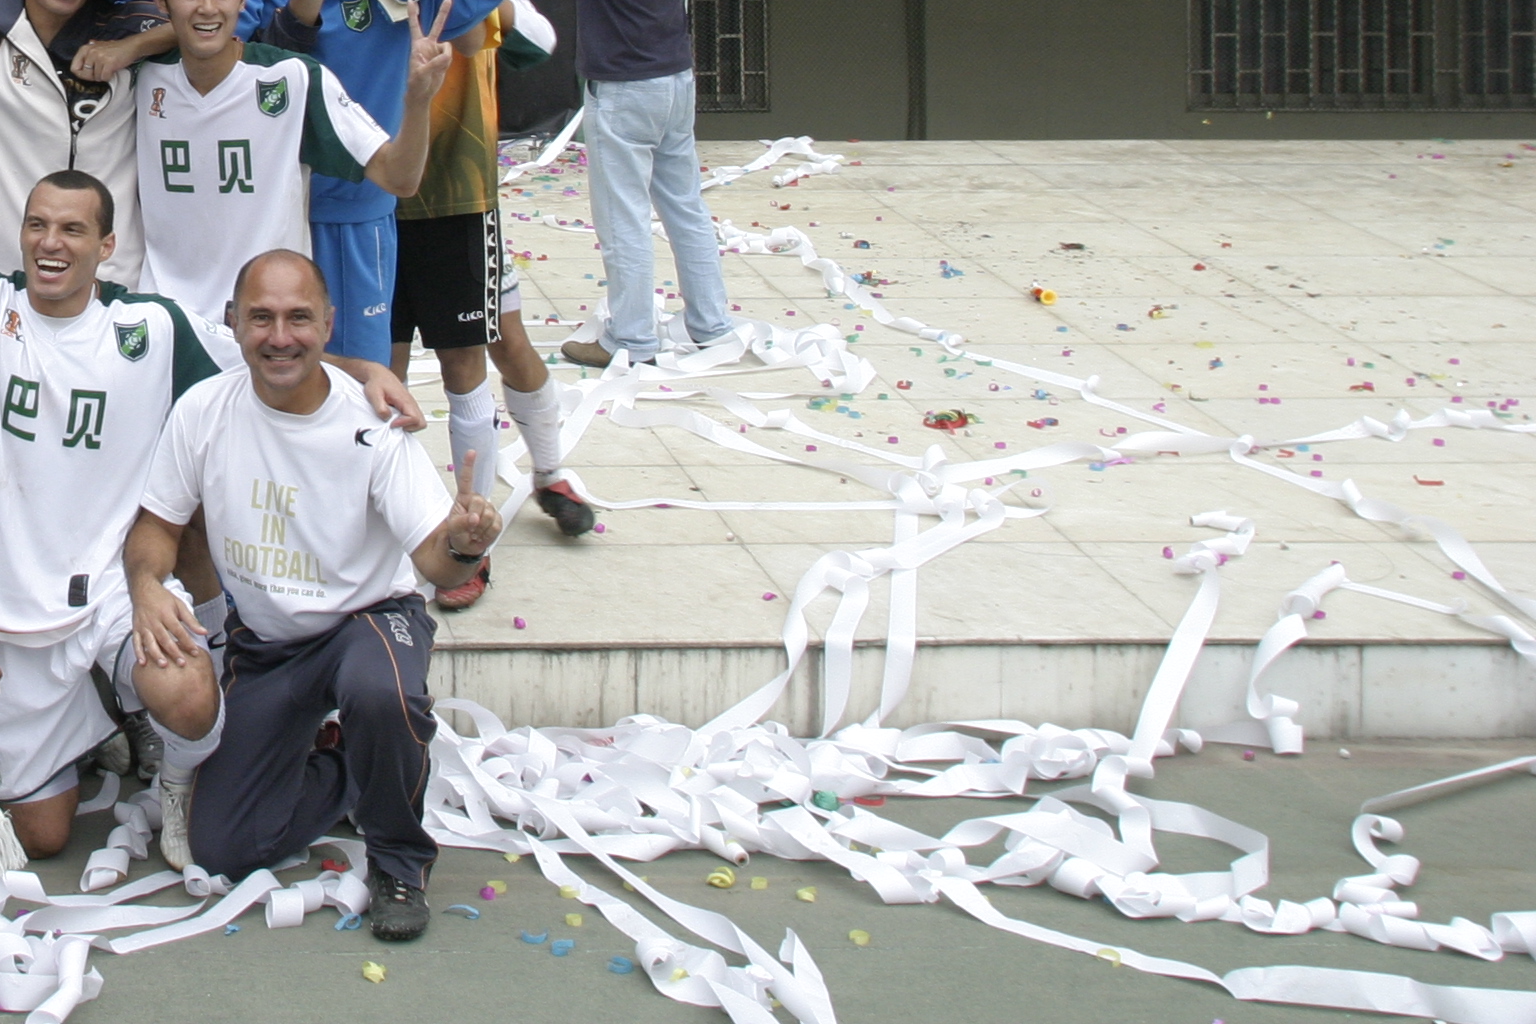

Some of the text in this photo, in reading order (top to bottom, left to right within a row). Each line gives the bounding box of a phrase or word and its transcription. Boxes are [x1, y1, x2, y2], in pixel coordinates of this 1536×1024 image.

[160, 139, 255, 194] 巴贝
[458, 310, 484, 322] KIKO
[2, 374, 107, 449] 巴贝
[261, 513, 286, 545] IN
[224, 536, 328, 585] FOOTBALL
